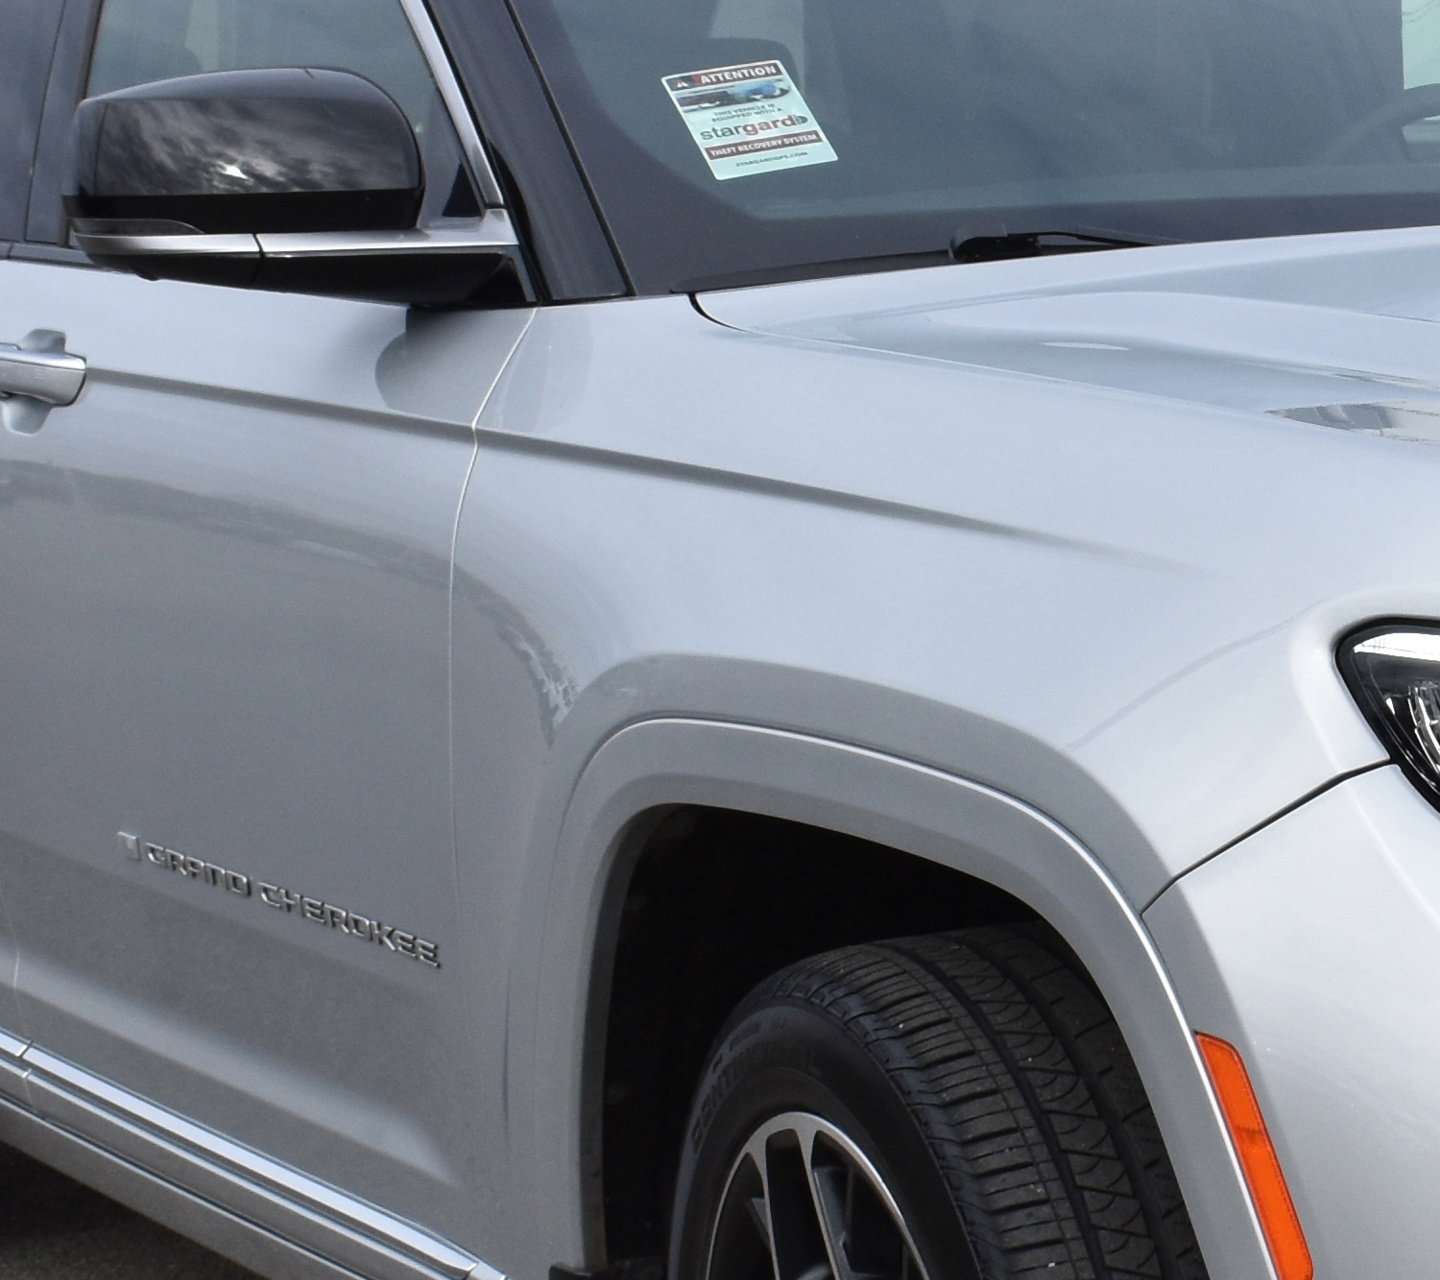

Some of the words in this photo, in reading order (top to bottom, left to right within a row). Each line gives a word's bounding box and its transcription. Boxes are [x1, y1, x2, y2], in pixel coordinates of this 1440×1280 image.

[699, 64, 778, 85] ATTENTION
[709, 146, 737, 158] THEFT
[737, 139, 782, 152] RECOVERY
[782, 133, 818, 145] SYSTEM
[145, 841, 253, 898] GRAND
[258, 881, 442, 969] CHEROKEE
